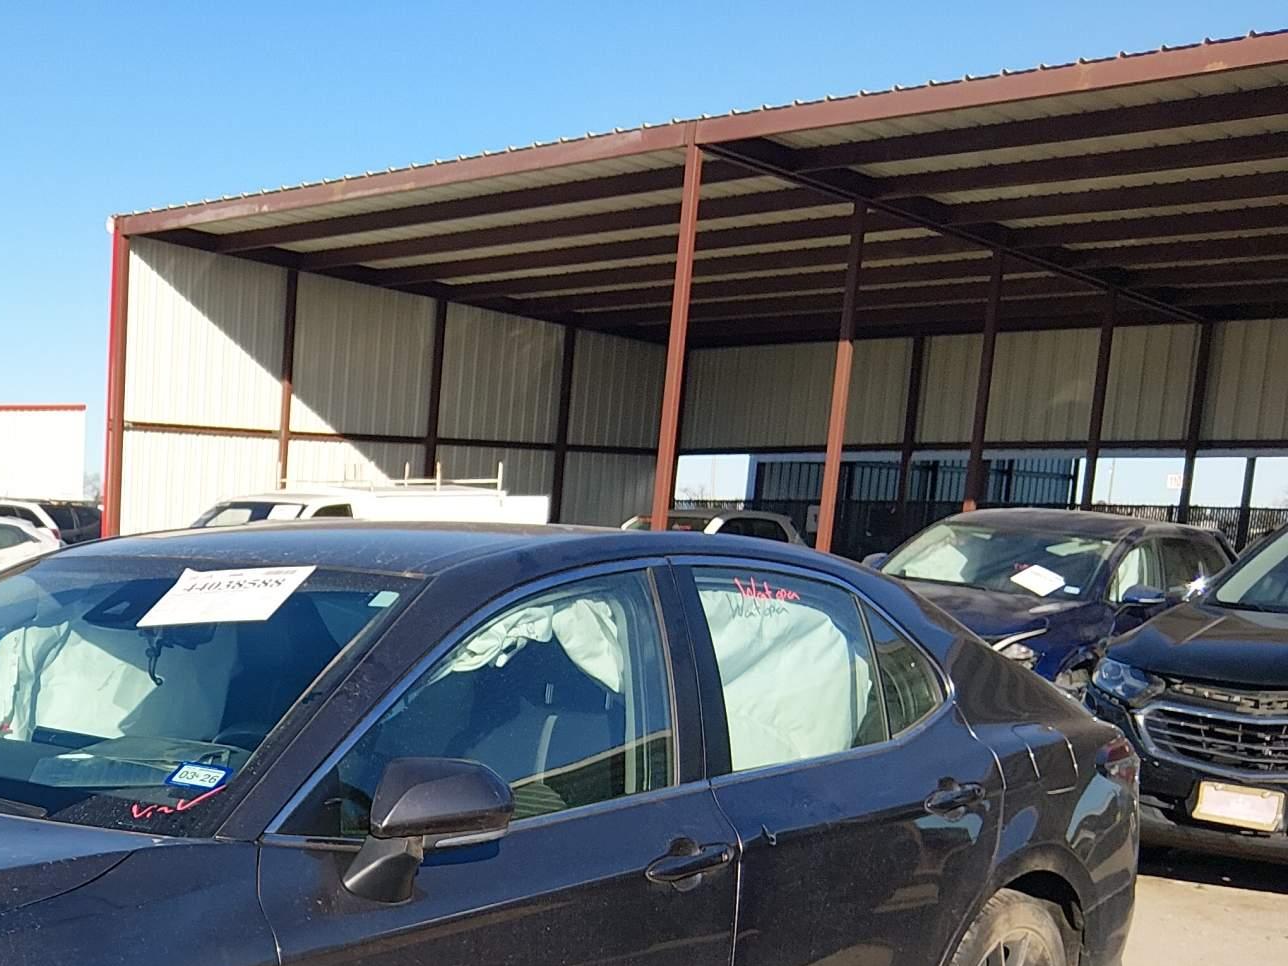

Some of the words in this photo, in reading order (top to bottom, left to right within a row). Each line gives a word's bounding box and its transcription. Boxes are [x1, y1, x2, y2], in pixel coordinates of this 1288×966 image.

[183, 578, 286, 592] 44038588
[178, 770, 196, 780] 03
[199, 773, 219, 784] 26
